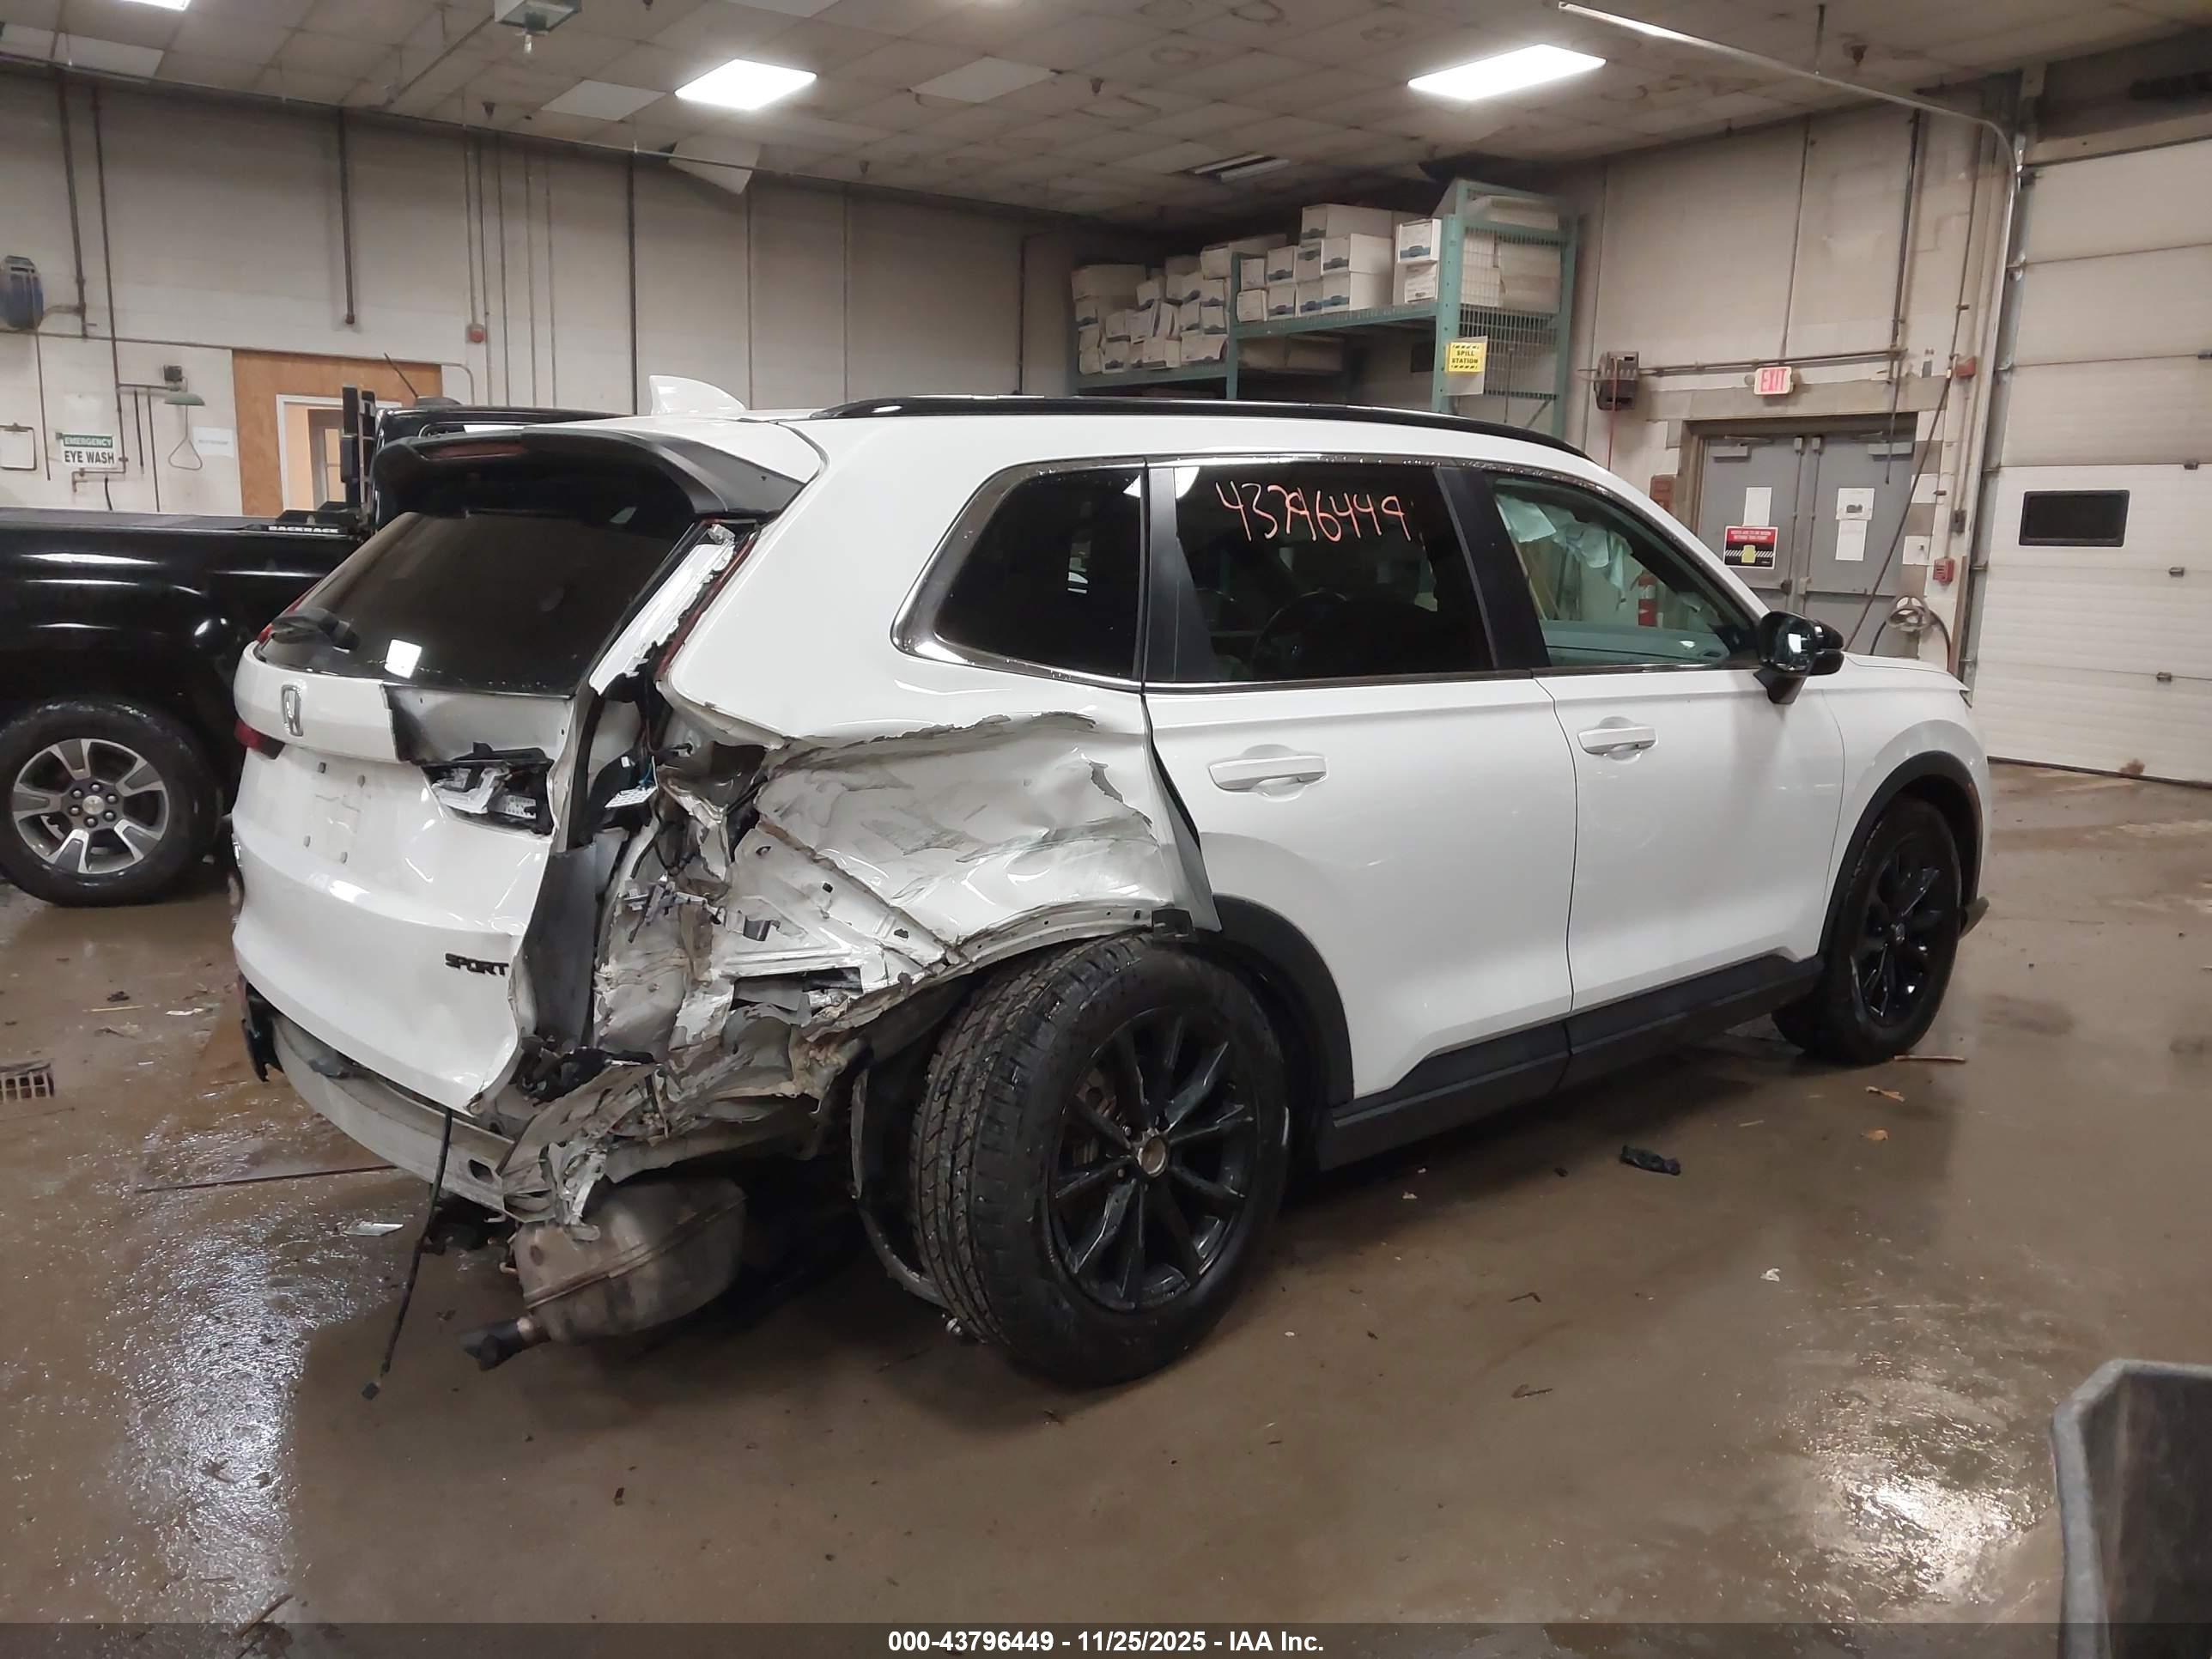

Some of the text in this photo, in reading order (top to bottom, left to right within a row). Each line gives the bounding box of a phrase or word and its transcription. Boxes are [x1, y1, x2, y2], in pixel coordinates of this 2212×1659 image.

[1759, 369, 1786, 392] EXIT
[64, 437, 112, 447] EMERGENCY
[64, 451, 114, 465] EYE WASH
[445, 952, 509, 975] SPORT
